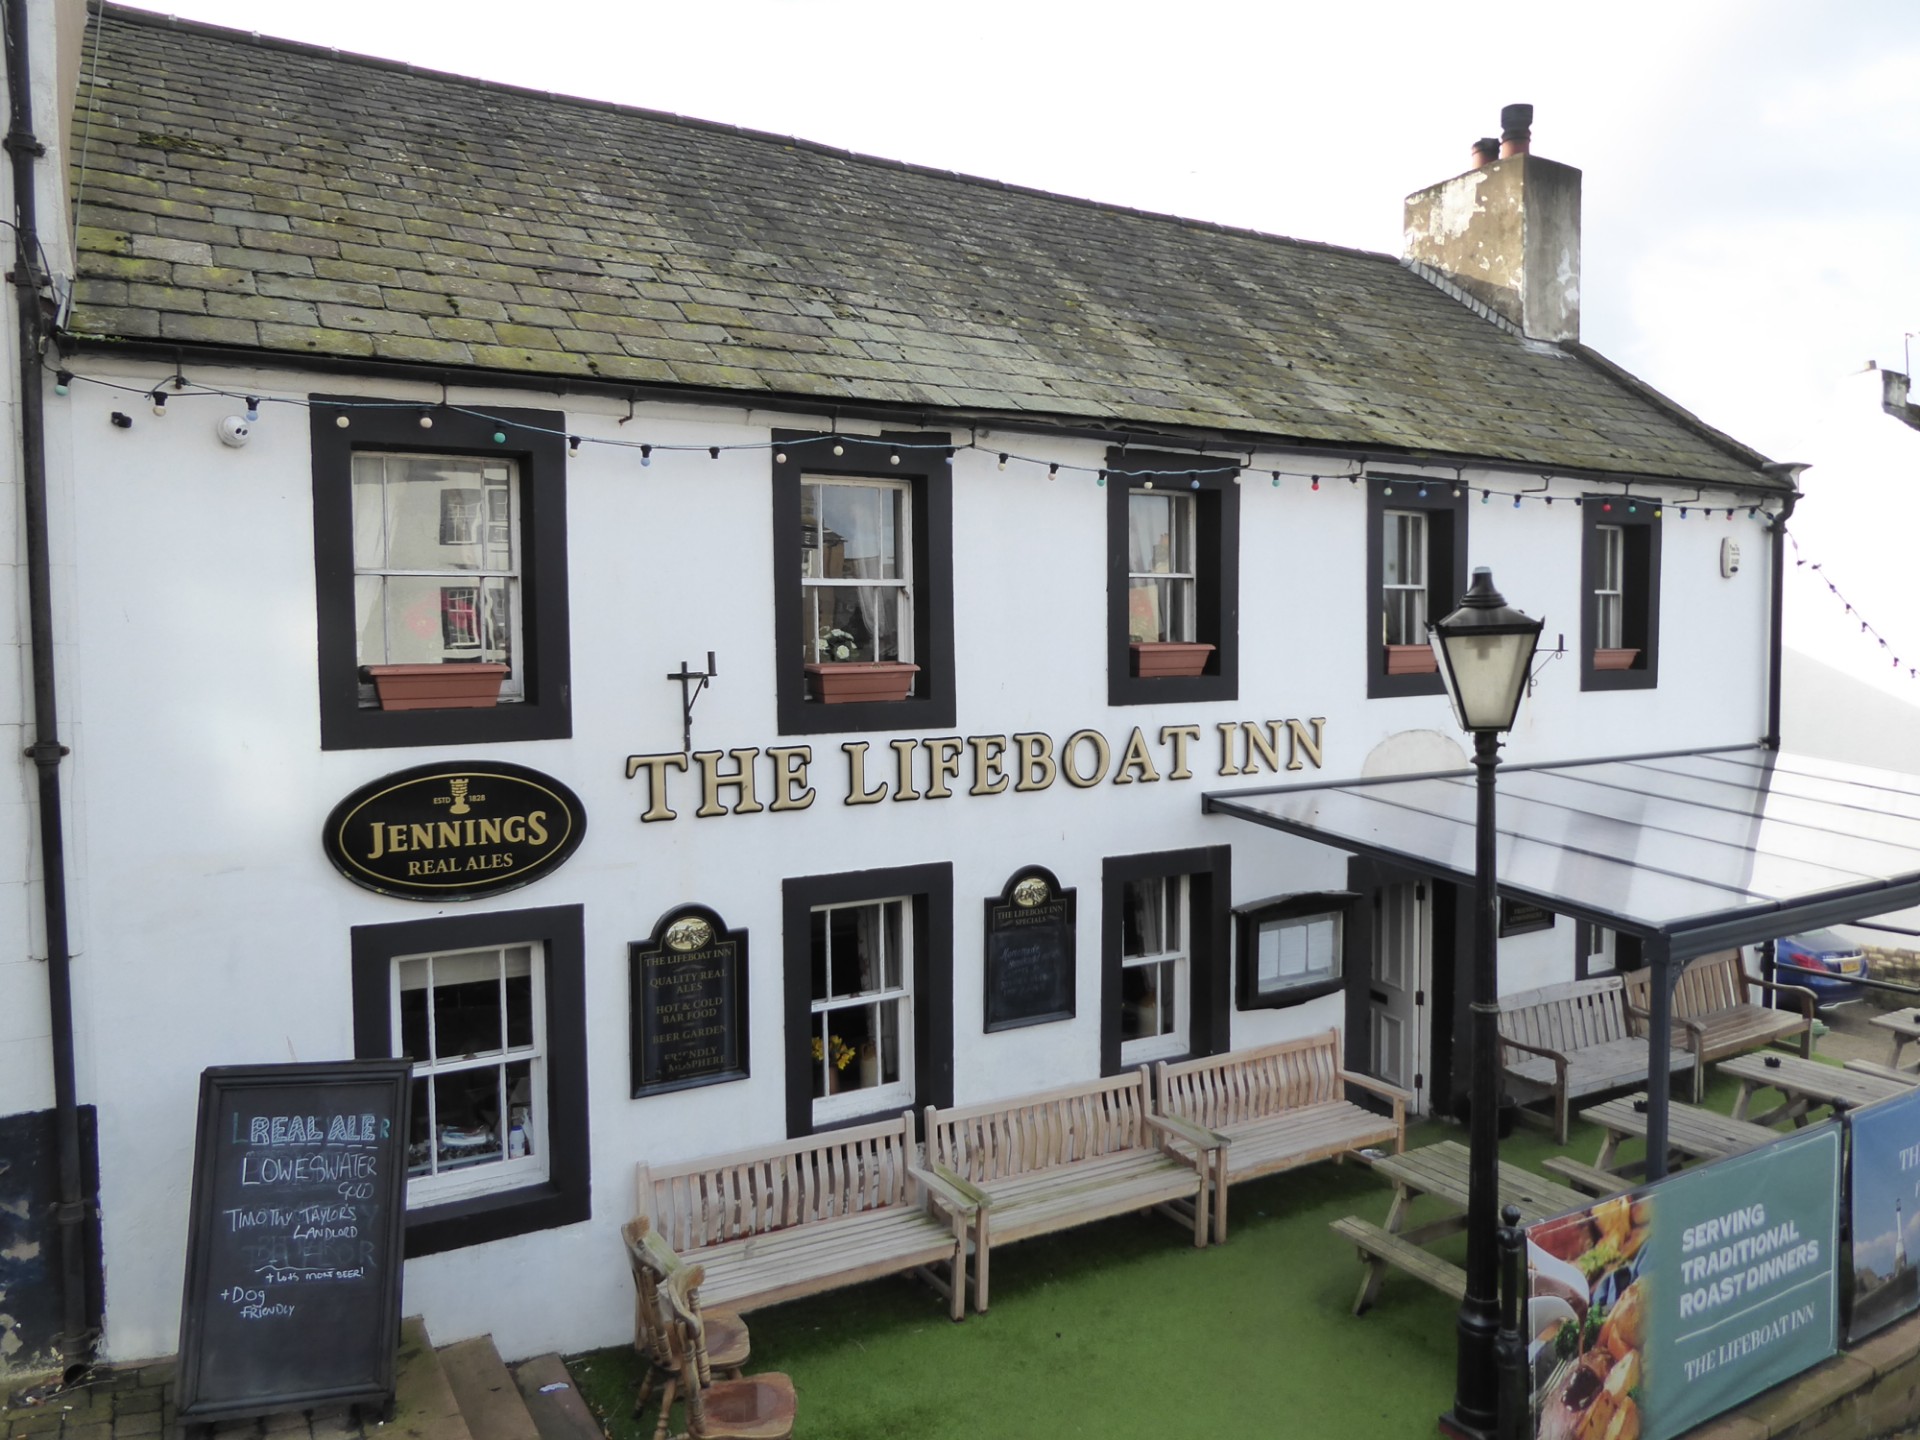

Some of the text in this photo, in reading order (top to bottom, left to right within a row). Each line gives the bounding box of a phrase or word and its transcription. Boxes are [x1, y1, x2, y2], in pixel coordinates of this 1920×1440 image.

[625, 717, 1327, 823] THE LIFEBOAT INN
[433, 794, 486, 805] ESTD 1828
[367, 810, 549, 859] JENNINGS
[408, 853, 514, 876] REAL ALES
[997, 904, 1063, 920] THE LIFEBOAT INN
[645, 948, 732, 967] THE LIFEBOAT INN
[650, 969, 728, 988] QUALITY REAL
[676, 983, 703, 995] ALES
[656, 997, 723, 1014] HOT & COLD
[663, 1009, 717, 1025] BAR FOOD
[653, 1025, 727, 1044] BEER GARDEN
[251, 1115, 324, 1145] REAL
[327, 1114, 376, 1141] ALE
[242, 1153, 377, 1185] LOWESWATER
[223, 1208, 293, 1232] TIMOTHY
[1682, 1203, 1765, 1252] SERVING
[293, 1225, 358, 1239] LANDLORD
[1681, 1219, 1800, 1285] TRADITIONAL
[1680, 1240, 1819, 1319] ROAST DINNERS
[1684, 1302, 1815, 1382] THE LIFEBOAT INN
